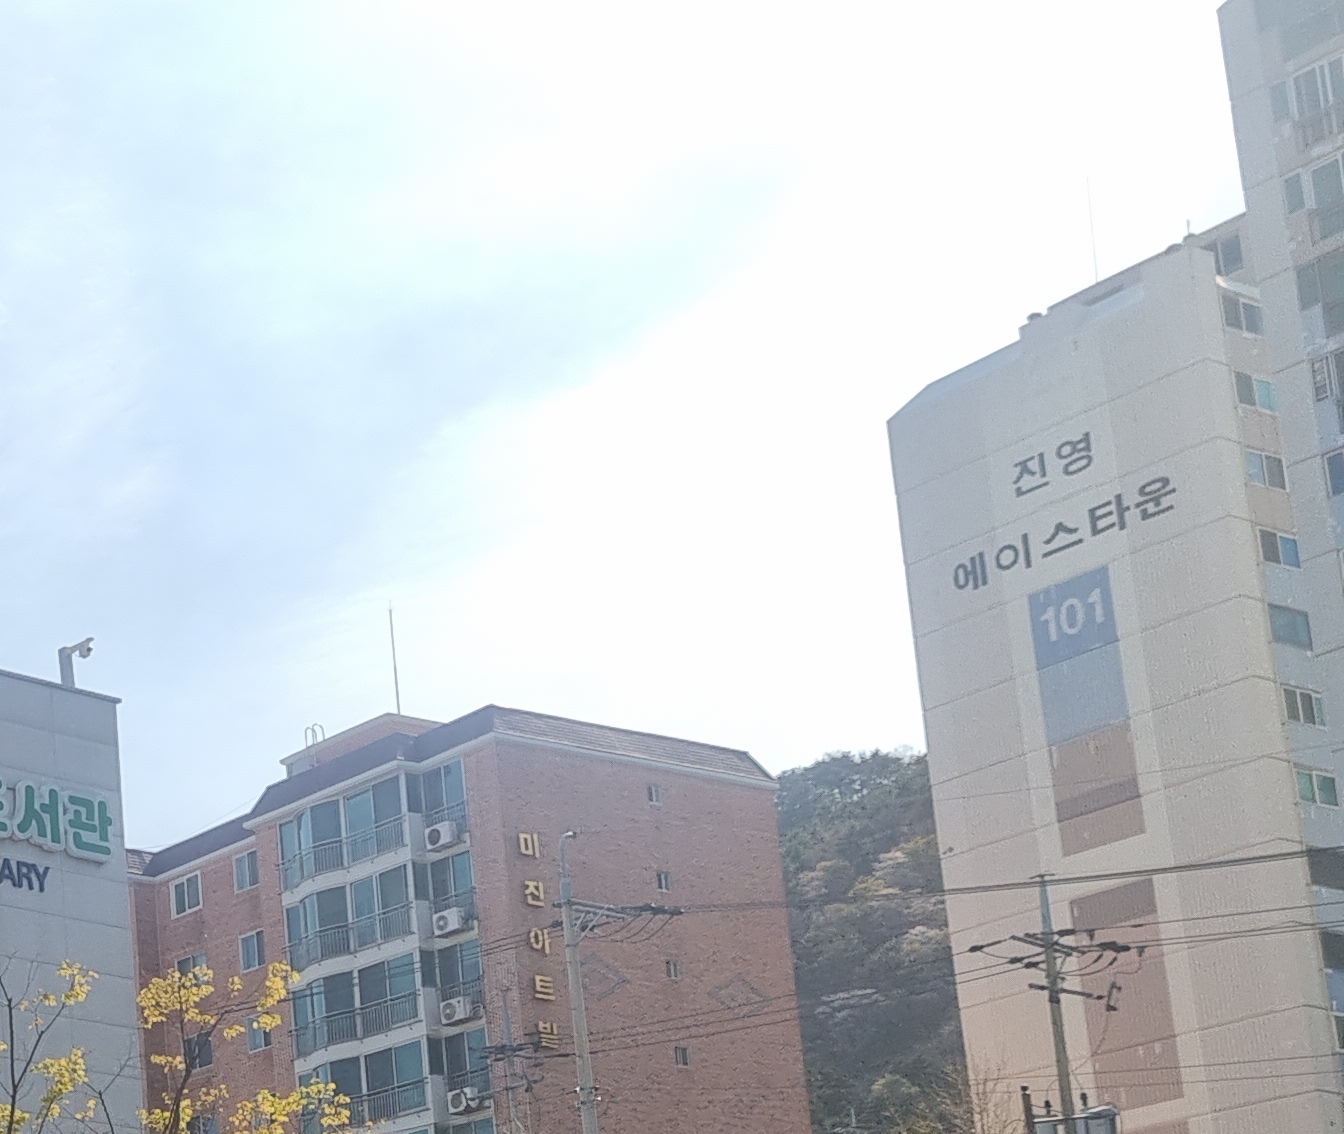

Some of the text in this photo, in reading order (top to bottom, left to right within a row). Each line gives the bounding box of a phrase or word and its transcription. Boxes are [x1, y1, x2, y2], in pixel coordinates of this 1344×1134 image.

[1012, 431, 1094, 498] 진영
[952, 475, 1177, 592] 에이스타운
[1040, 587, 1108, 643] 101
